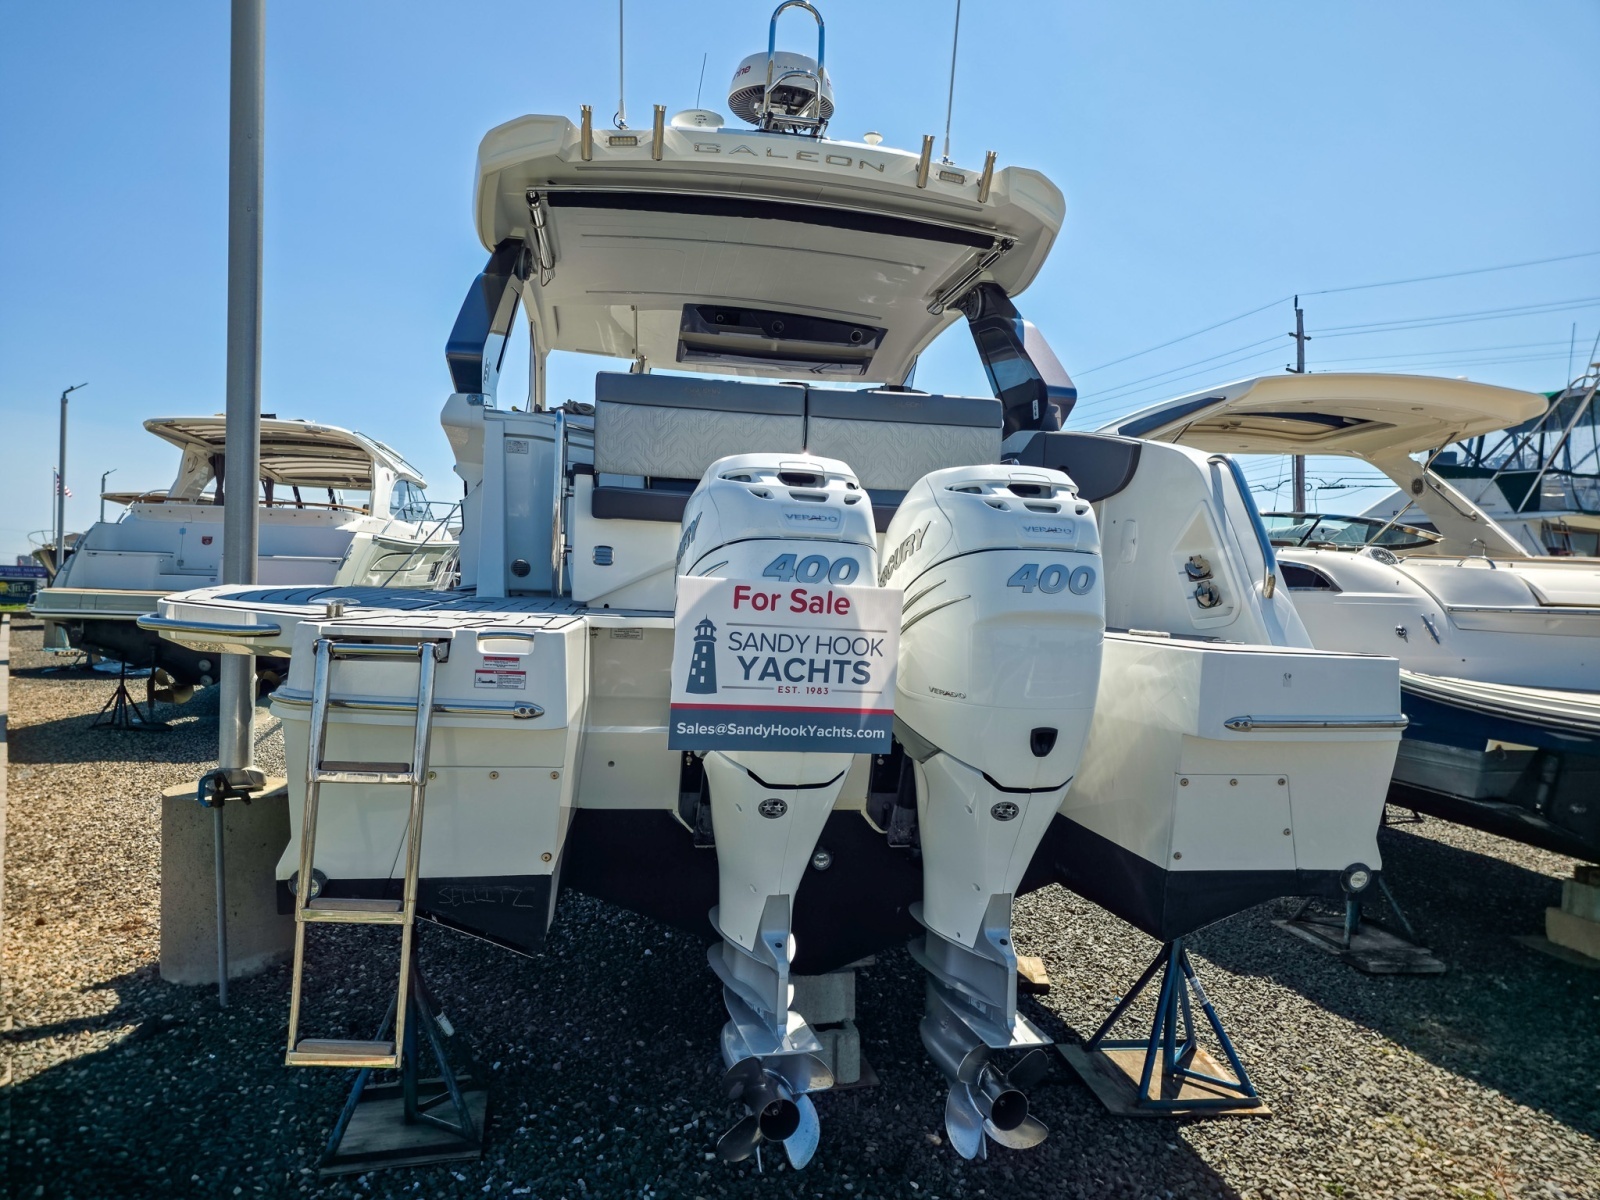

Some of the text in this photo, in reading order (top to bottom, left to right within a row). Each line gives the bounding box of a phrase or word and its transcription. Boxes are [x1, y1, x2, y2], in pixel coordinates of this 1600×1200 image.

[693, 142, 885, 173] GALEON
[784, 513, 838, 523] VERADO
[1022, 525, 1072, 535] VERADO
[762, 553, 860, 585] 400
[1006, 563, 1097, 596] 400
[733, 585, 851, 616] For Sale
[728, 631, 885, 657] SANDY HOOK
[737, 655, 872, 685] YACHTS
[778, 685, 829, 695] EST. 1983
[929, 685, 967, 699] VERADO
[676, 722, 885, 739] Sales@SandyHookYachts.com
